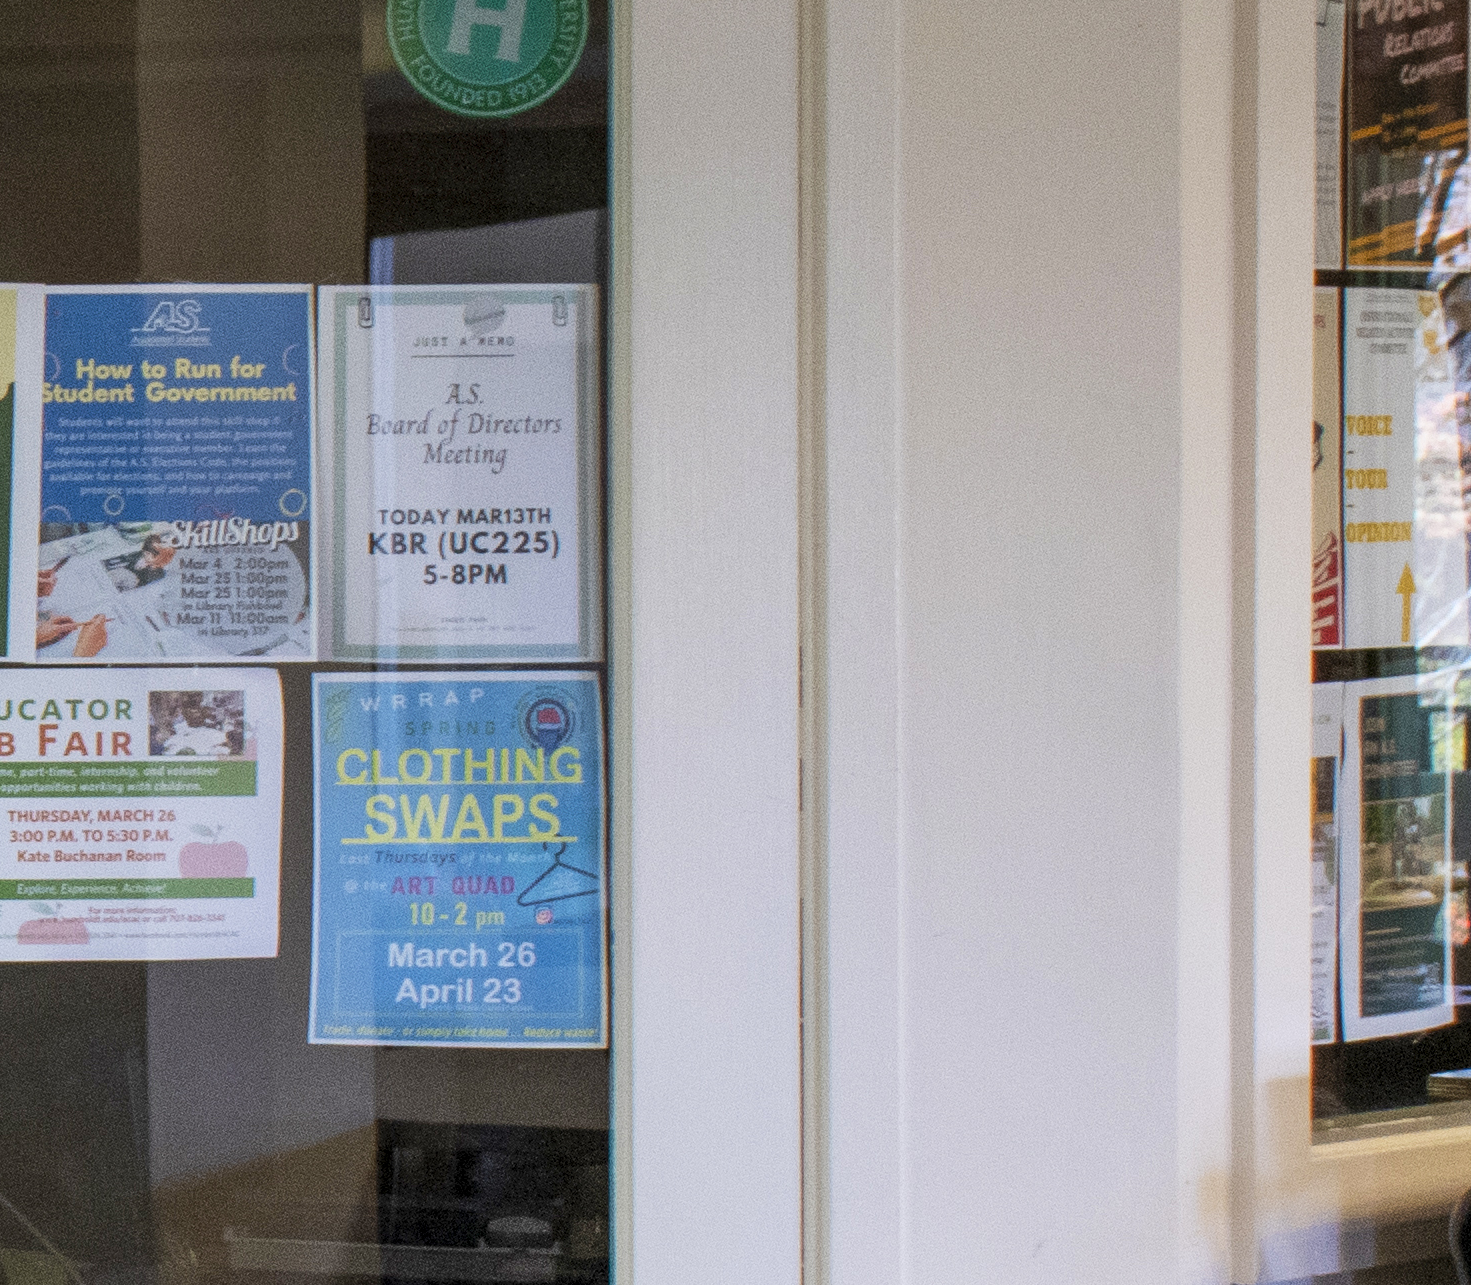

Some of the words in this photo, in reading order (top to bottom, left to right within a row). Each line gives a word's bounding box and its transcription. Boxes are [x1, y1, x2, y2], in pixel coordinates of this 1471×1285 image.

[410, 54, 503, 107] FOUNDED
[76, 358, 132, 379] How
[142, 359, 166, 379] to
[174, 358, 222, 379] Run
[230, 355, 265, 378] for
[43, 382, 134, 403] Student
[146, 381, 296, 402] Government
[445, 383, 483, 405] A.S.
[367, 413, 429, 435] Board
[438, 411, 460, 446] of
[468, 412, 562, 435] Directors
[423, 442, 507, 474] Meeting
[378, 509, 449, 524] TODAY
[457, 508, 551, 524] MAR13TH
[368, 532, 426, 555] KBR
[438, 530, 560, 558] (UC225)
[424, 564, 507, 584] 5-8PM
[336, 746, 582, 784] CLOTHING
[8, 810, 92, 824] THURSDAY,
[98, 810, 153, 822] MARCH
[158, 810, 177, 822] 26
[364, 793, 561, 841] SWAPS
[10, 830, 43, 843] 3:00
[47, 830, 78, 842] P.M.
[83, 830, 103, 842] TO
[106, 829, 139, 842] 5:30
[142, 829, 173, 842] P.M.
[17, 850, 50, 862] Kate
[54, 850, 122, 862] Buchanan
[126, 850, 166, 862] Room
[391, 876, 437, 895] ART
[451, 876, 516, 895] QUAD
[389, 942, 487, 967] March
[497, 941, 535, 967] 26
[395, 977, 473, 1008] April
[483, 978, 521, 1003] 23
